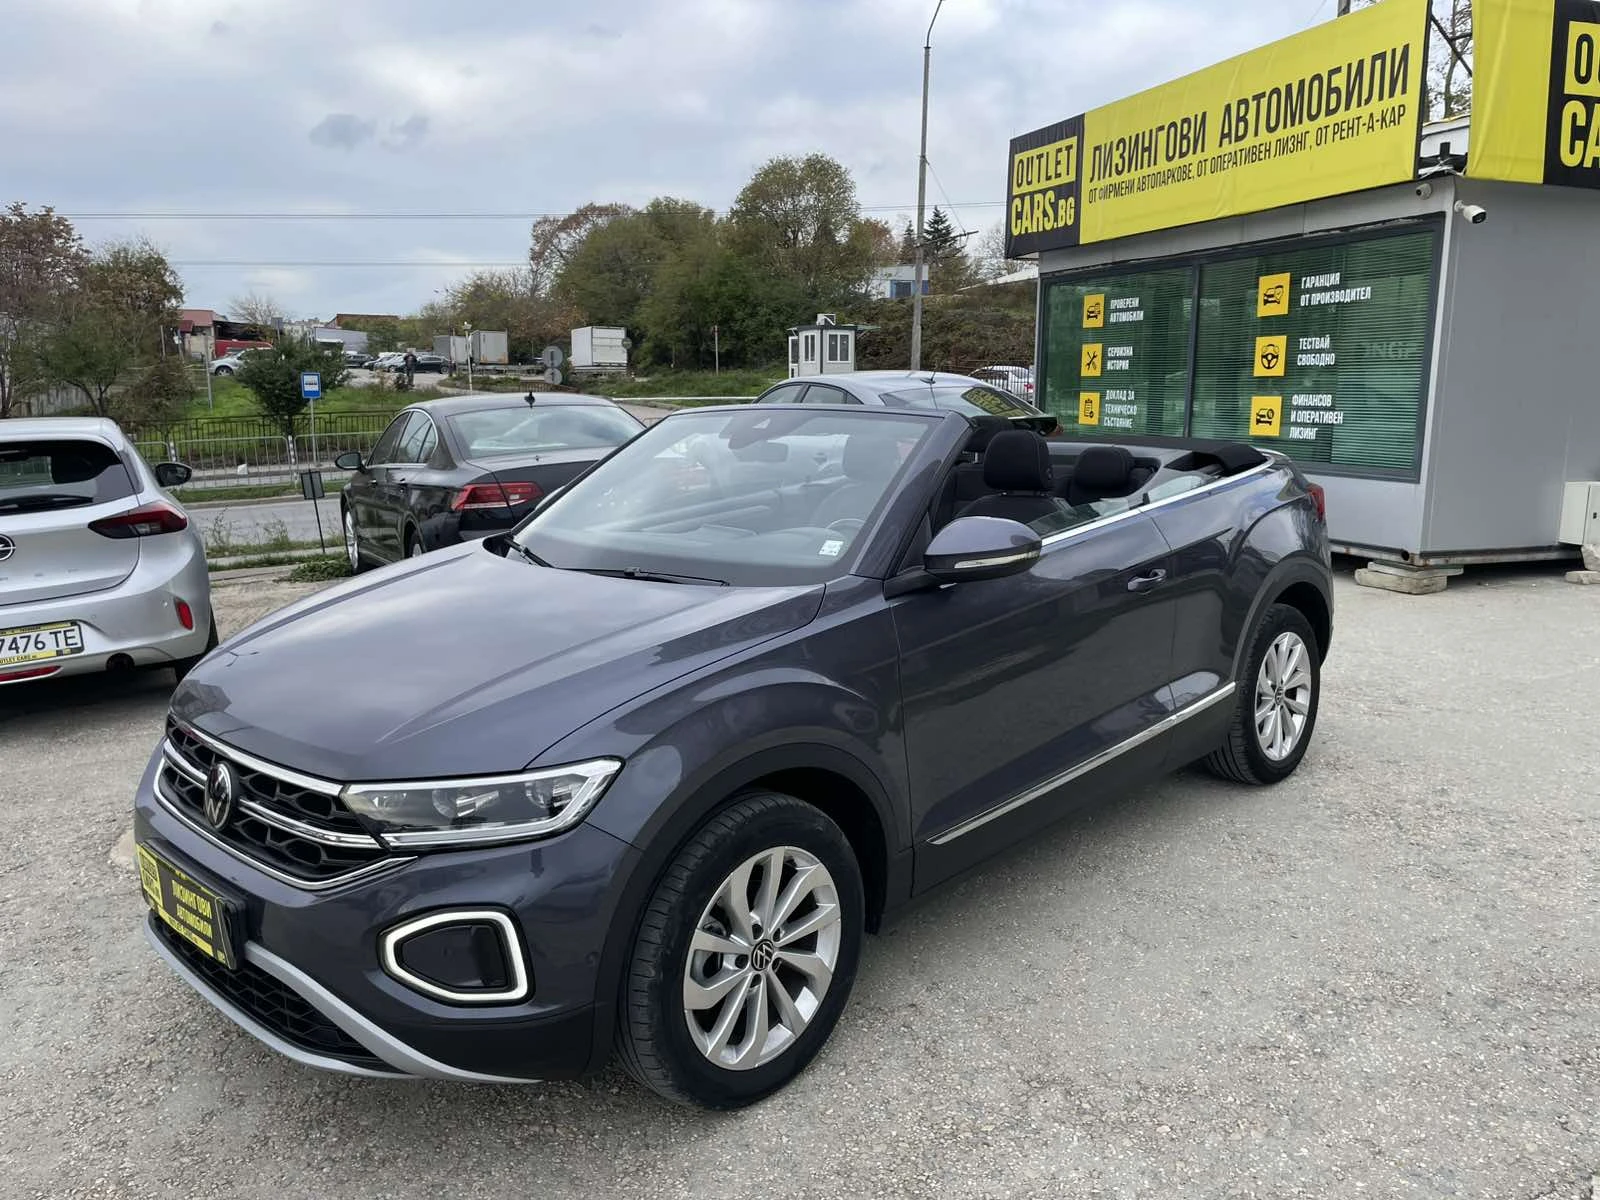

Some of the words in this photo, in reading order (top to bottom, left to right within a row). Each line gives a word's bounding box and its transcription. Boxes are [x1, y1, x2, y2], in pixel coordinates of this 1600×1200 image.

[1574, 33, 1600, 85] O
[1089, 110, 1207, 183] ЛИЗИНГОВИ
[1218, 43, 1410, 148] АВТОМОБИЛИ
[1088, 188, 1098, 204] ОТ
[1136, 163, 1195, 192] АВТОПАРКОВЕ,
[1197, 159, 1209, 178] ОТ
[1210, 141, 1271, 174] ОПЕРАТИВЕН
[1315, 124, 1330, 147] ОТ
[1332, 104, 1406, 143] РЕНТ-А-КАР
[1016, 144, 1074, 188] OUTLET
[1011, 190, 1075, 236] CARS.BG
[1301, 272, 1340, 289] ГАРАНЦИЯ
[1110, 297, 1140, 310] ПРОВЕРЕНИ
[1300, 293, 1310, 307] ОТ
[1311, 286, 1372, 305] ПРОИЗВОДИТЕЛ
[1110, 311, 1144, 323] АВТОМОБИЛИ
[1299, 334, 1330, 350] ТЕСТВАЙ
[1297, 353, 1335, 367] СВОБОДНО
[1105, 390, 1127, 402] ДОКЛАД
[1128, 390, 1135, 400] ЗА
[1292, 394, 1332, 407] ФИНАНСОВ
[1290, 410, 1297, 422] И
[1297, 410, 1343, 424] ОПЕРАТИВЕН
[1289, 427, 1318, 440] ЛИЗИНГ
[49, 628, 78, 648] TE
